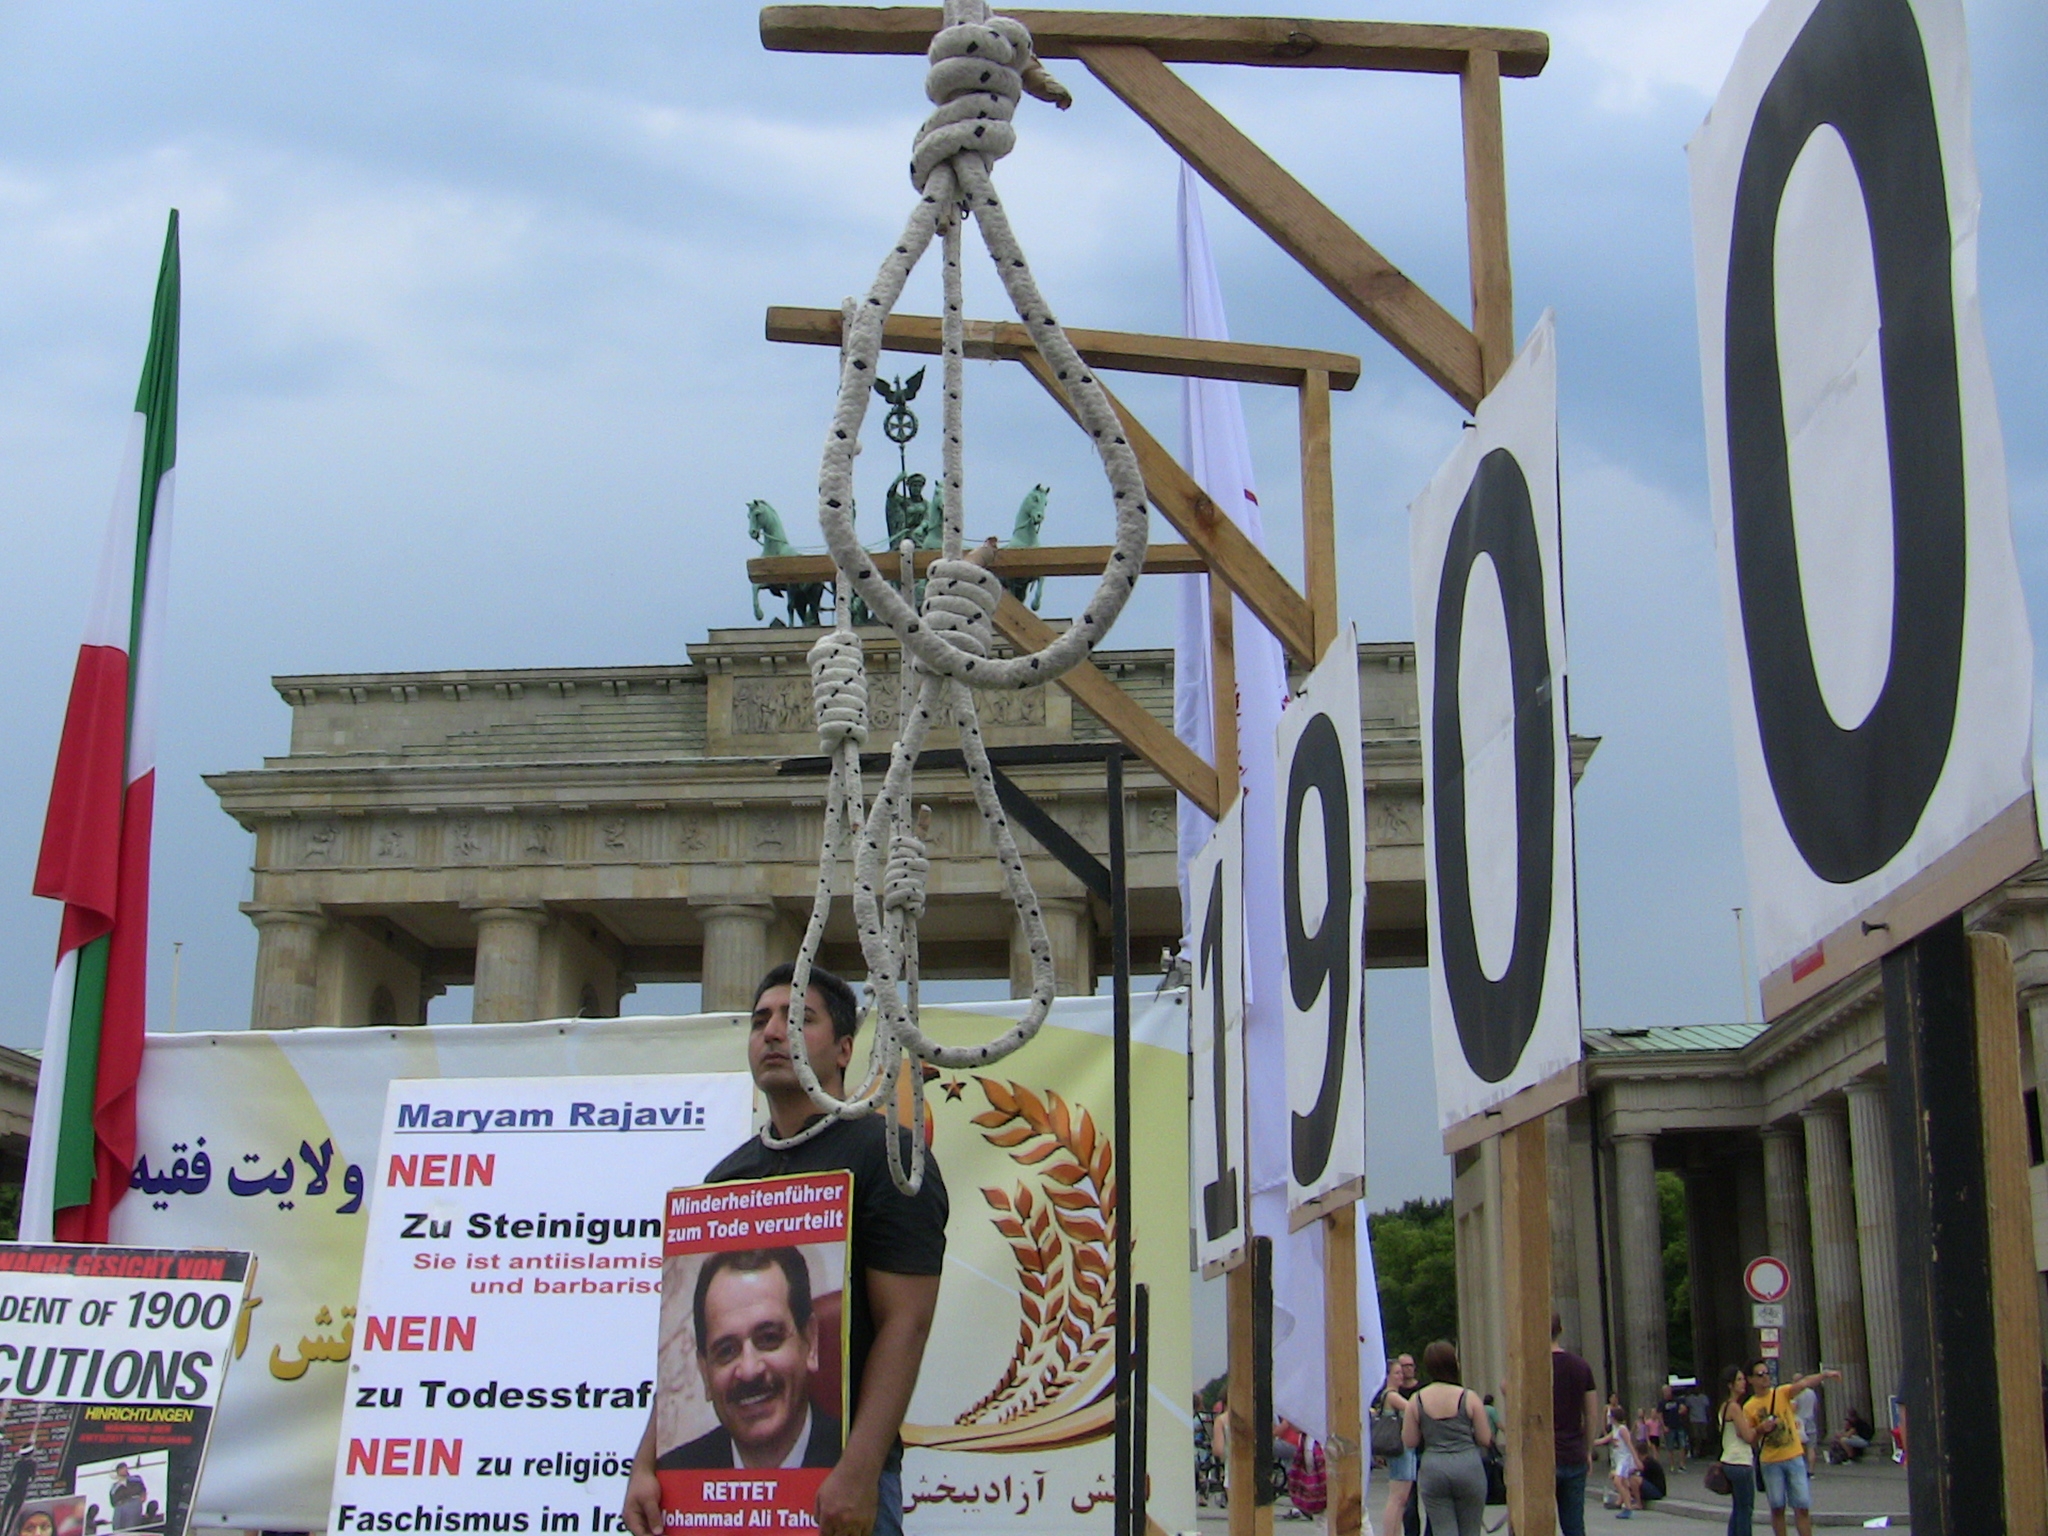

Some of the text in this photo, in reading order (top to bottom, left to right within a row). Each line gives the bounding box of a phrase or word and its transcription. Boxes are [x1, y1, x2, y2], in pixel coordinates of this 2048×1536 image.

[1725, 0, 1966, 884] 0
[1433, 447, 1556, 1085] 0
[1284, 711, 1352, 1187] 9
[1201, 859, 1238, 1242] 1
[397, 1101, 706, 1134] Maryam Rajavi:
[228, 1138, 364, 1213] ولایت
[387, 1154, 495, 1187] NEIN
[670, 1184, 844, 1217] Minderheitenführer
[399, 1212, 661, 1245] Zu Steinigun
[667, 1209, 844, 1244] zum Tode verurteilt
[75, 1254, 174, 1279] GESICHT
[176, 1257, 227, 1281] VON
[413, 1252, 663, 1270] Sie ist antiislamis
[470, 1277, 524, 1294] und
[79, 1299, 118, 1327] OF
[128, 1290, 232, 1330] 1900
[363, 1316, 476, 1351] NEIN
[355, 1380, 656, 1409] zu Todesstraf
[84, 1405, 195, 1423] HINRICHTUNGEN
[346, 1438, 634, 1484] NEIN zu religiös
[702, 1480, 779, 1502] RETTET
[337, 1504, 529, 1533] Faschismus
[541, 1505, 580, 1533] im
[749, 1508, 772, 1528] Ali
